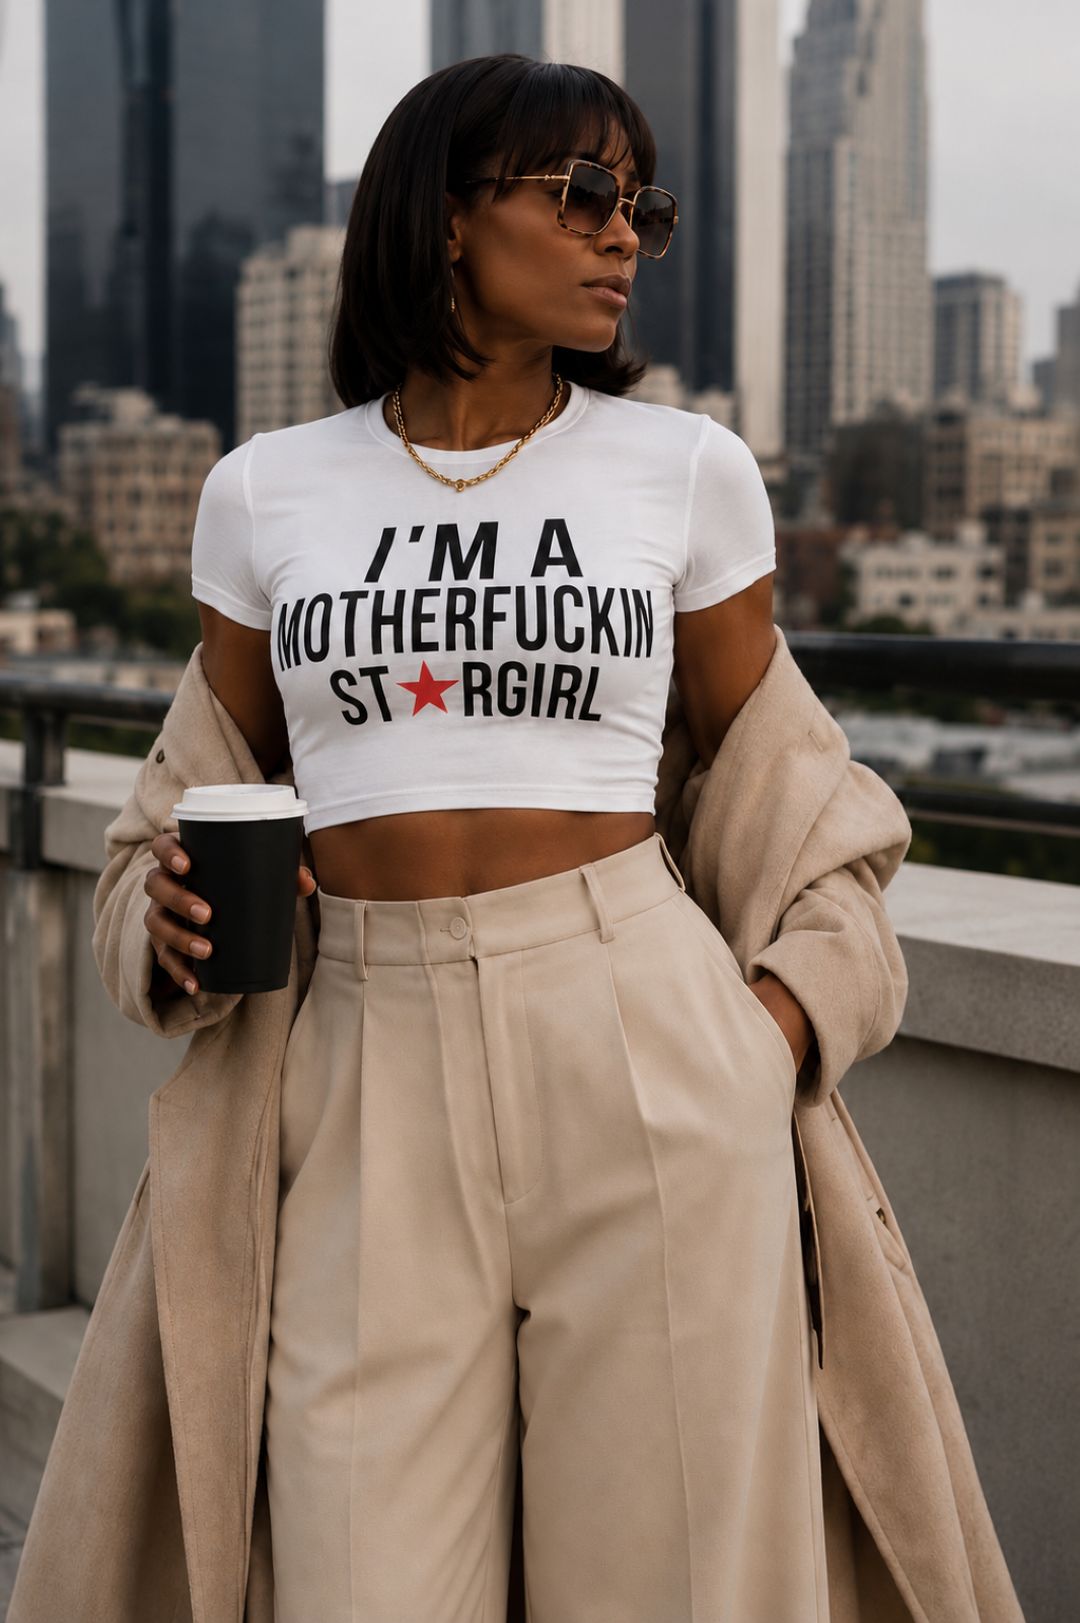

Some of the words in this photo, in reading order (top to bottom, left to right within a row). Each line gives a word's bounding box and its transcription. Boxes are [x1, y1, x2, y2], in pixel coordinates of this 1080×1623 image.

[364, 521, 499, 583] I'M
[530, 518, 584, 578] A
[277, 584, 654, 673] MOTHERFUCKIN
